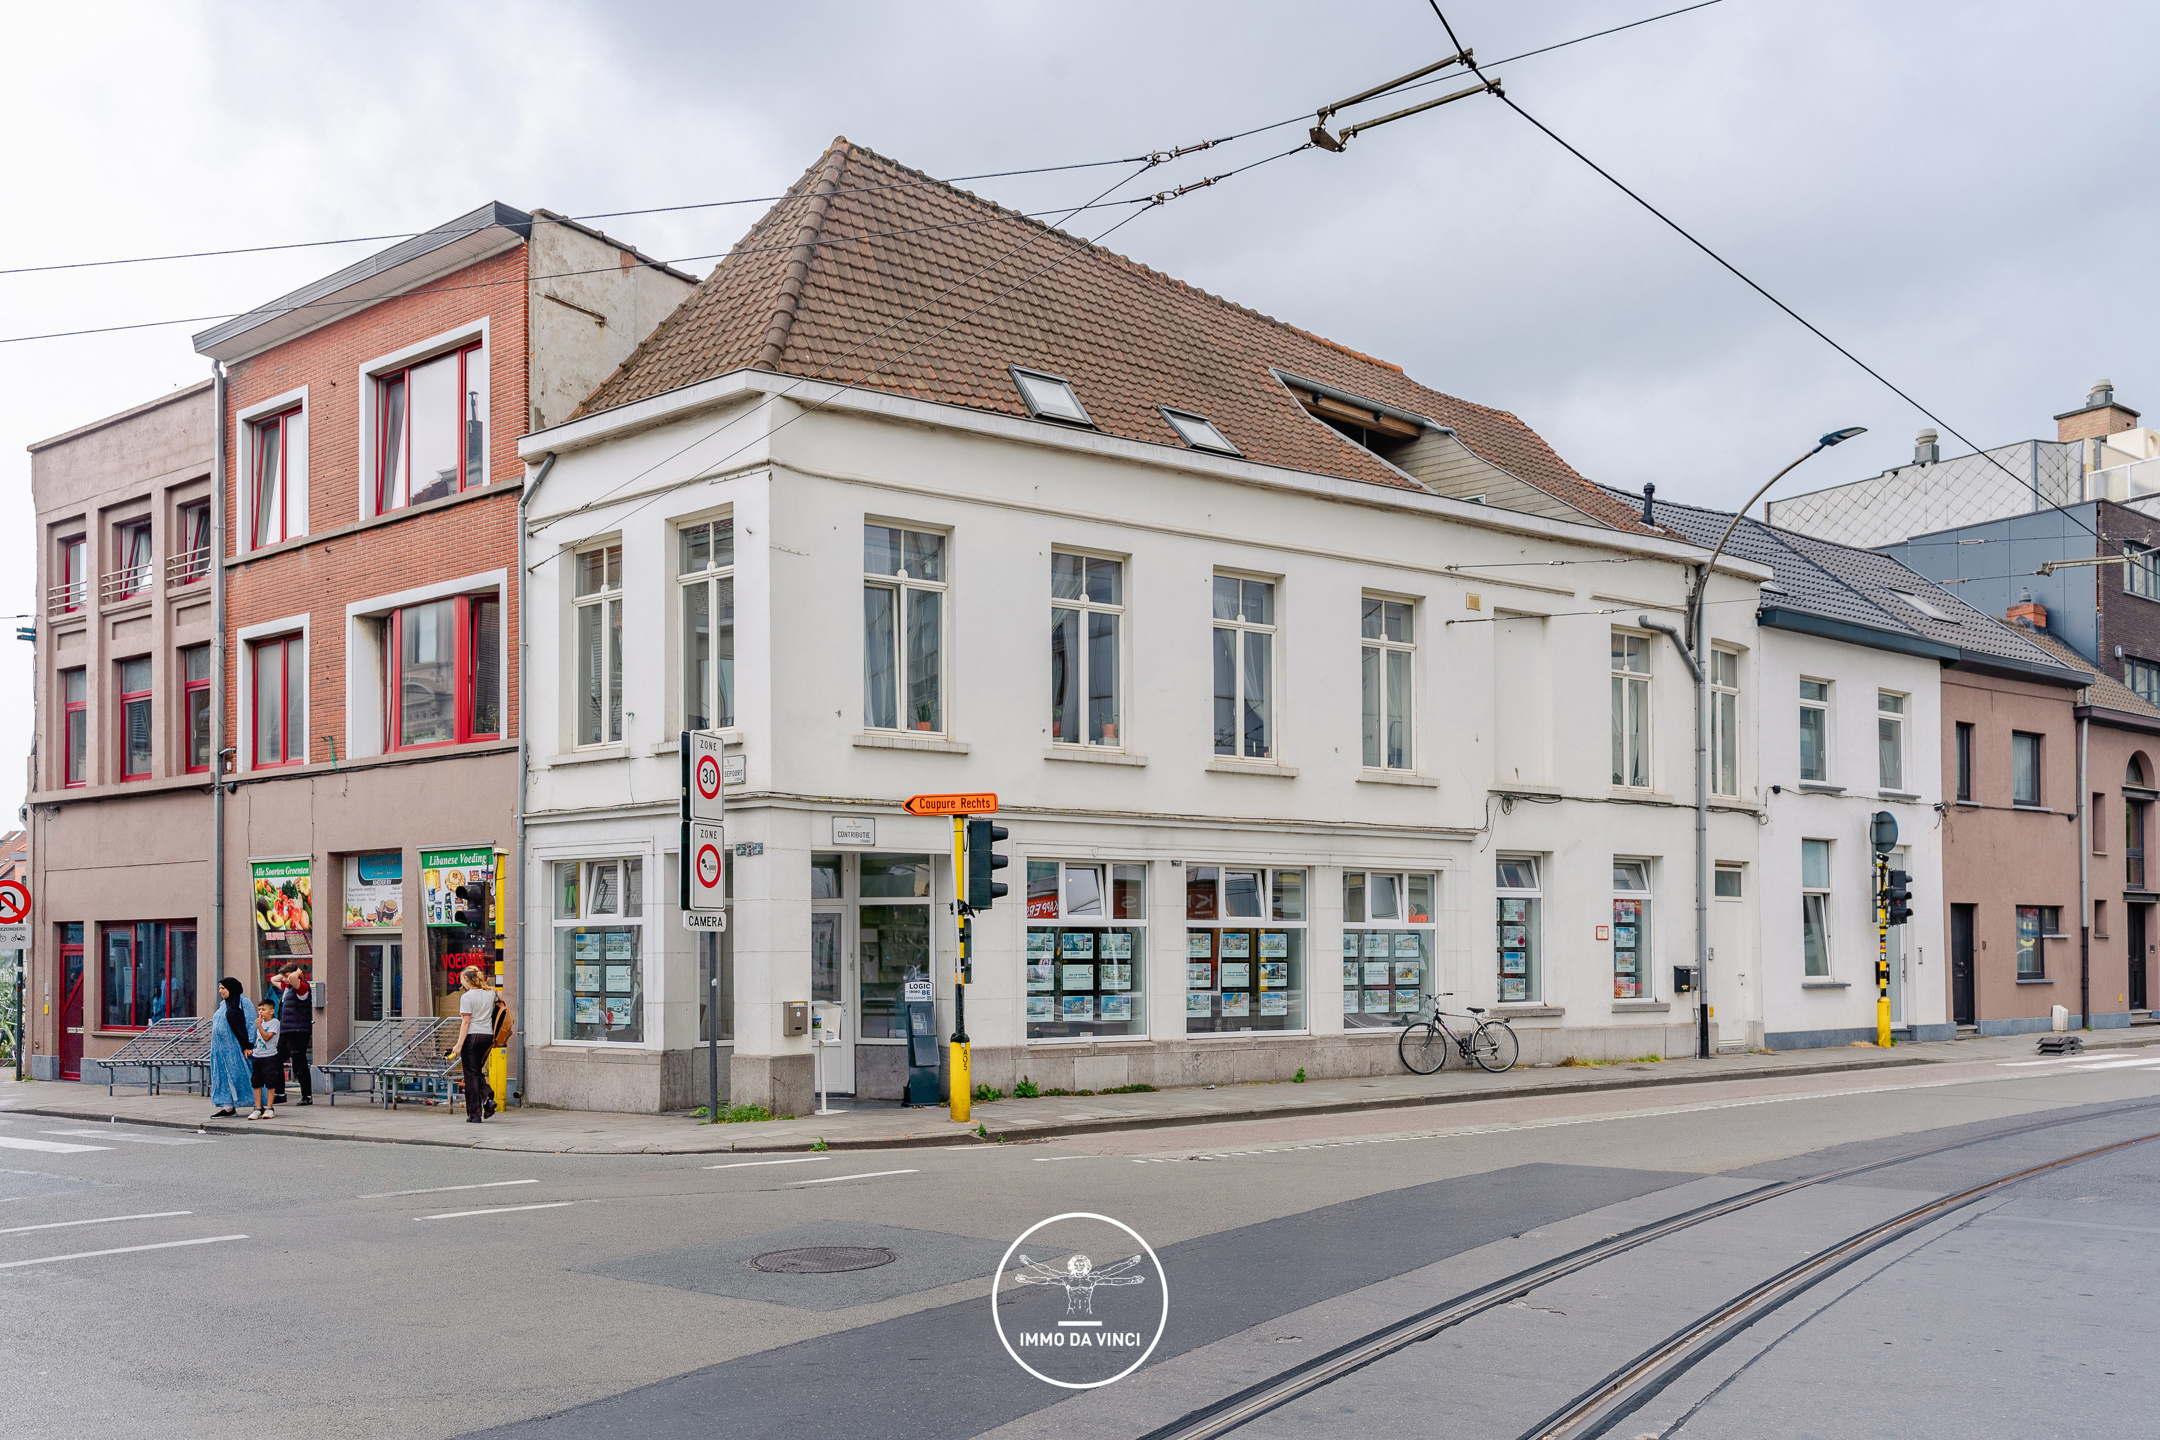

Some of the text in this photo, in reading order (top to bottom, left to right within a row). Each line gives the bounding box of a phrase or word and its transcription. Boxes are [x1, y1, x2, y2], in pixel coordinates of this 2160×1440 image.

[700, 740, 717, 751] ZONE
[702, 768, 716, 785] 30
[724, 769, 743, 778] SEPOORT
[919, 798, 991, 811] Coupure Rechts
[700, 829, 717, 840] ZONE
[837, 830, 870, 839] CONTRIBUTIE
[429, 852, 487, 866] Libanese Voeding
[254, 866, 309, 877] Alle Soorten Groenten
[688, 916, 723, 927] CAMERA
[442, 952, 485, 969] VOEDING
[448, 971, 462, 985] SY
